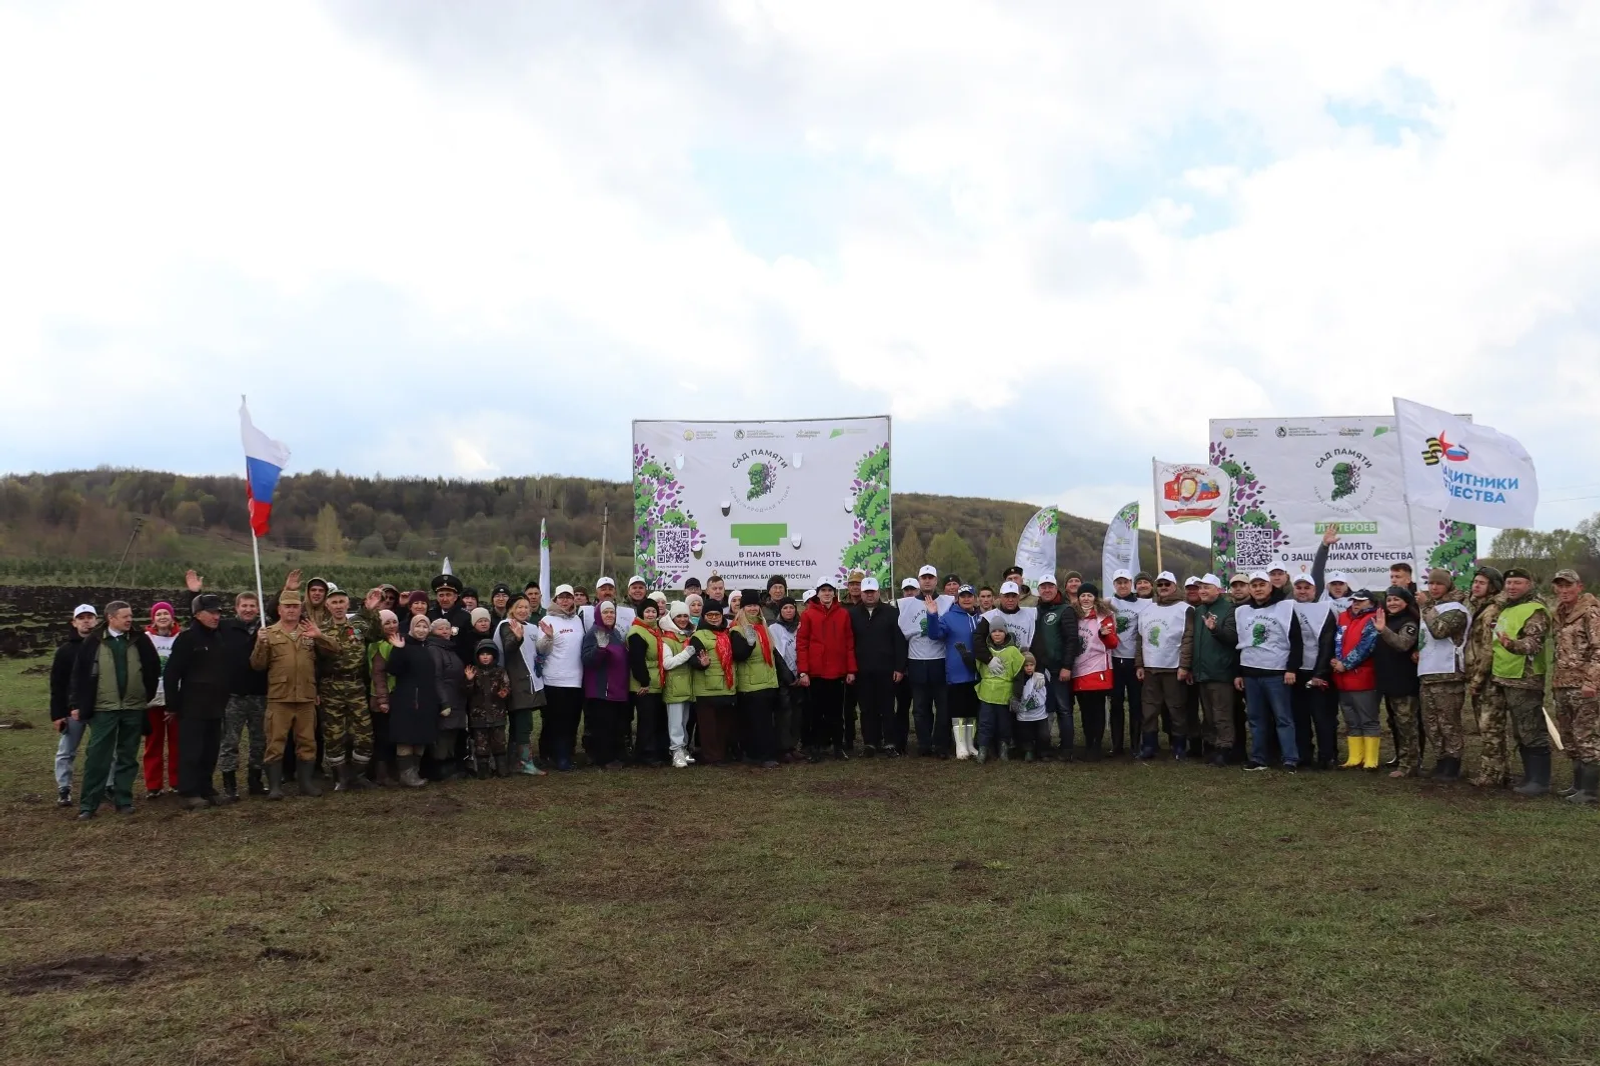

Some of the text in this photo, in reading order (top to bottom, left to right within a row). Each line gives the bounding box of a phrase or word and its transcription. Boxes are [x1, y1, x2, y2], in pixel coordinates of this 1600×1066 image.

[731, 448, 789, 469] САД ПАМЯТИ
[1315, 448, 1373, 469] САД ПАМЯТИ
[1338, 523, 1376, 532] ГЕРОЕВ
[1331, 542, 1373, 551] ПАМЯТЬ
[1281, 551, 1413, 563] О ЗАЩНИКАХ ОТЕЧЕСТВА
[705, 559, 817, 568] О ЗАЩИТНИКЕ ОТЕЧЕСТВА
[1408, 626, 1416, 634] Z
